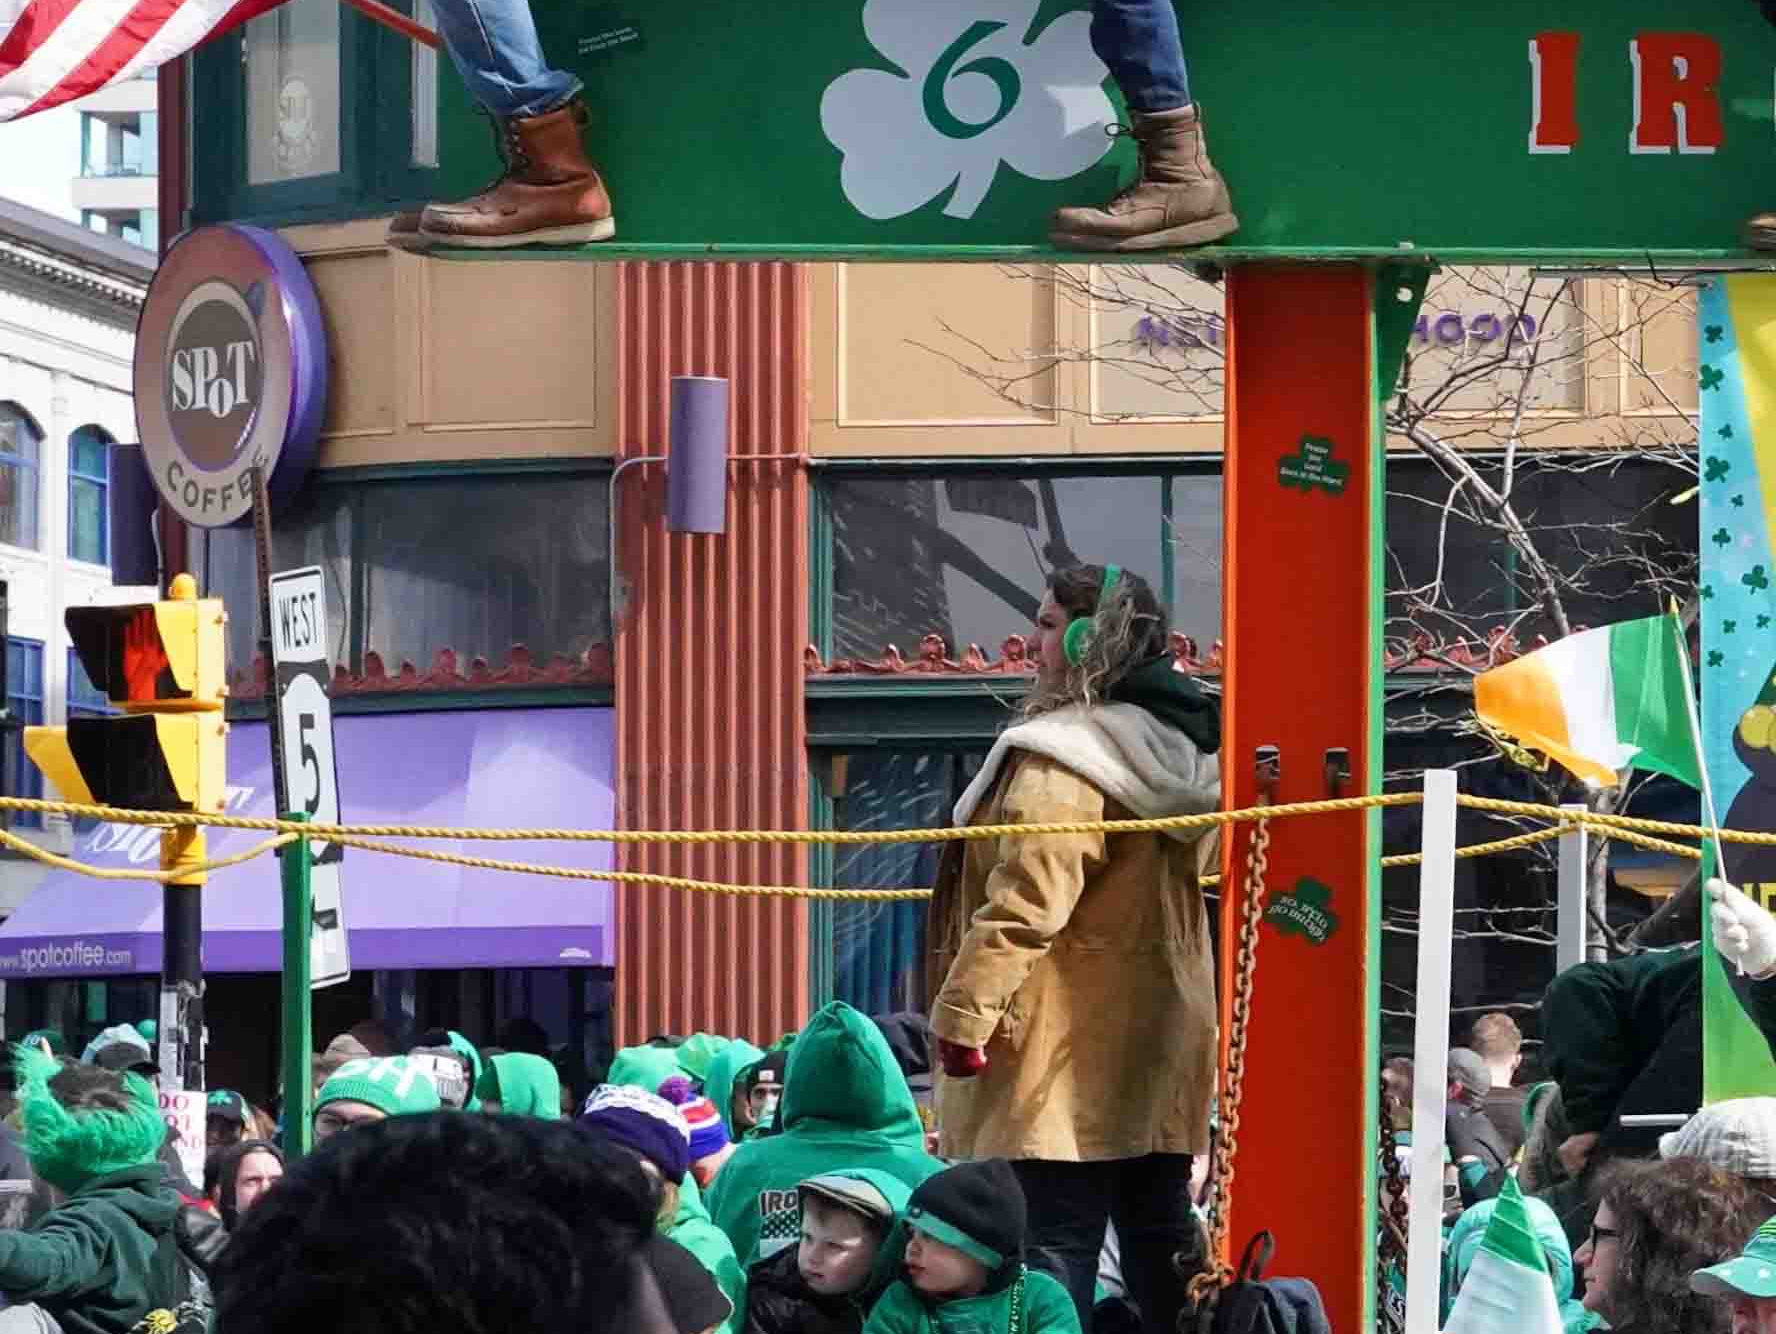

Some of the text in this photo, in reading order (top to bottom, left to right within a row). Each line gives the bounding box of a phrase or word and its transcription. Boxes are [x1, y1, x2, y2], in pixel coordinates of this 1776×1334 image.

[922, 20, 1021, 140] 6
[279, 591, 320, 651] WEST
[298, 712, 320, 817] 5
[760, 1189, 800, 1218] IRO
